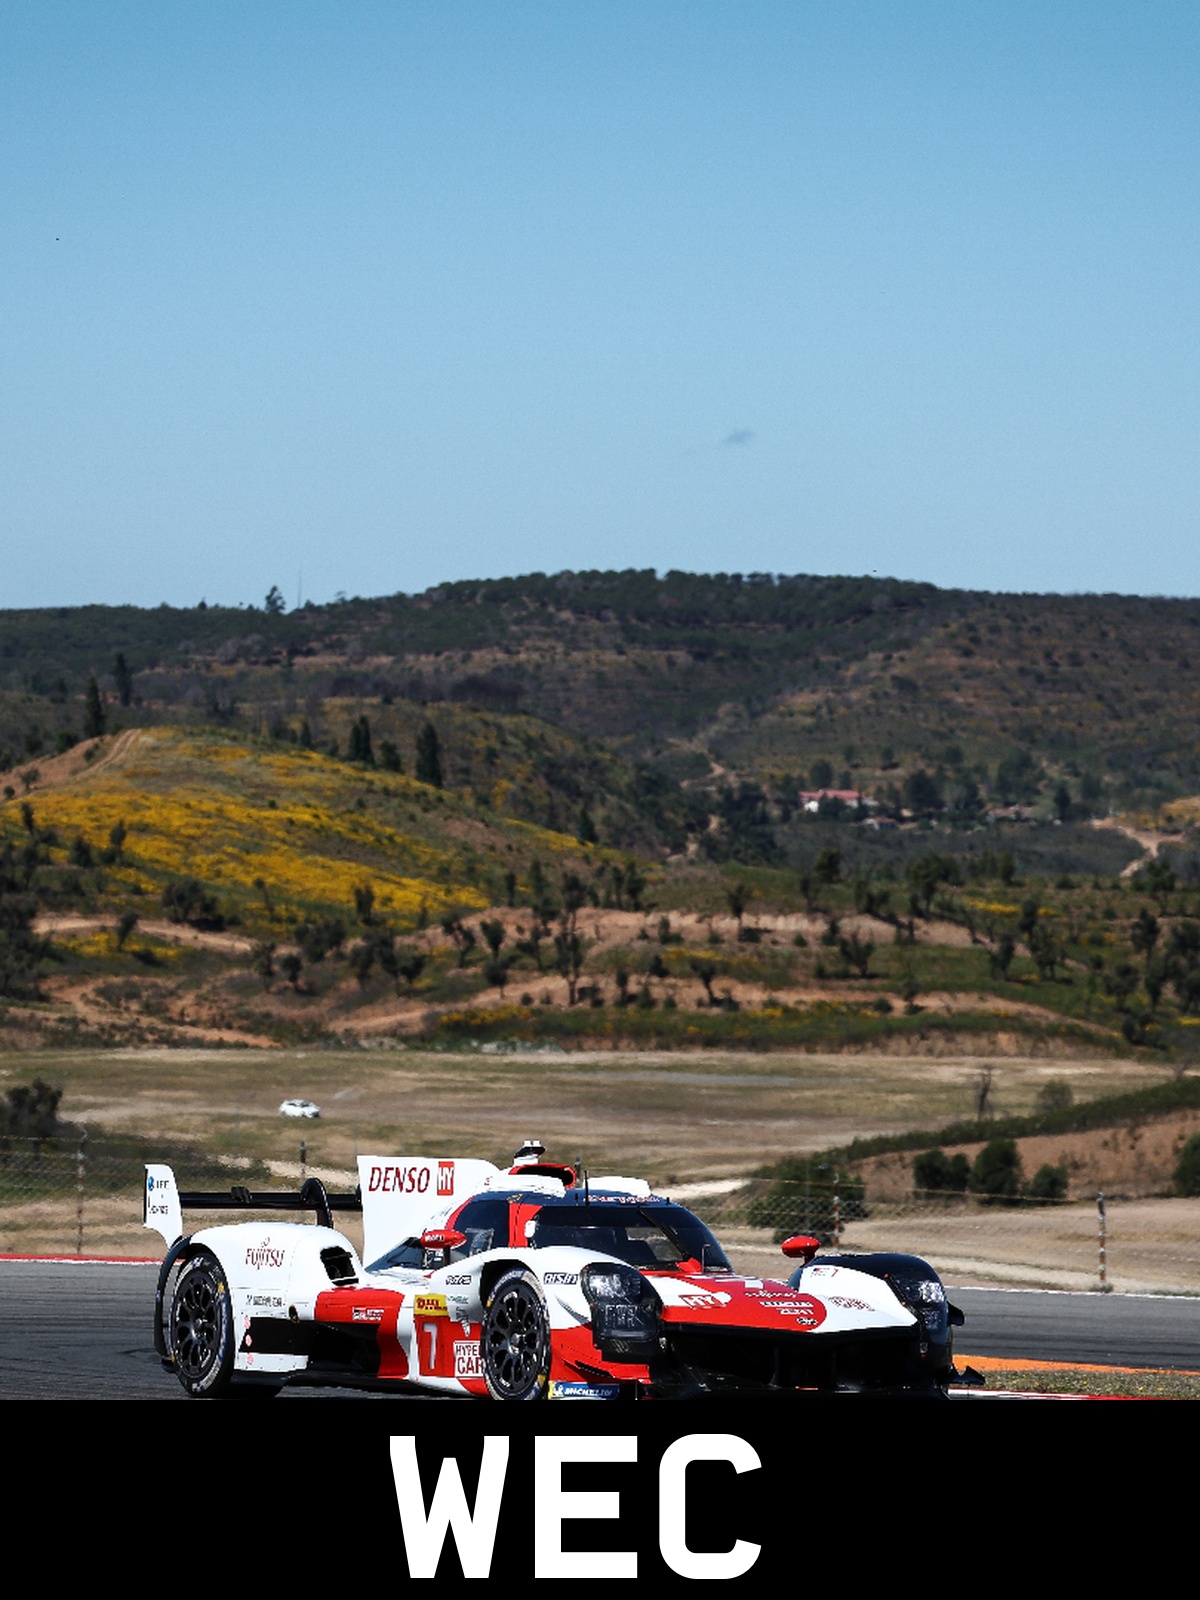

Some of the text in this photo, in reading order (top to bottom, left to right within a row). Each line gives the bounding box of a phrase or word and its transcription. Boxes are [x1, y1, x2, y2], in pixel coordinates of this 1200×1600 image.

[368, 1166, 431, 1193] DENSO
[438, 1166, 454, 1190] HY
[245, 1247, 286, 1270] FUJITSU
[423, 1322, 438, 1370] 7
